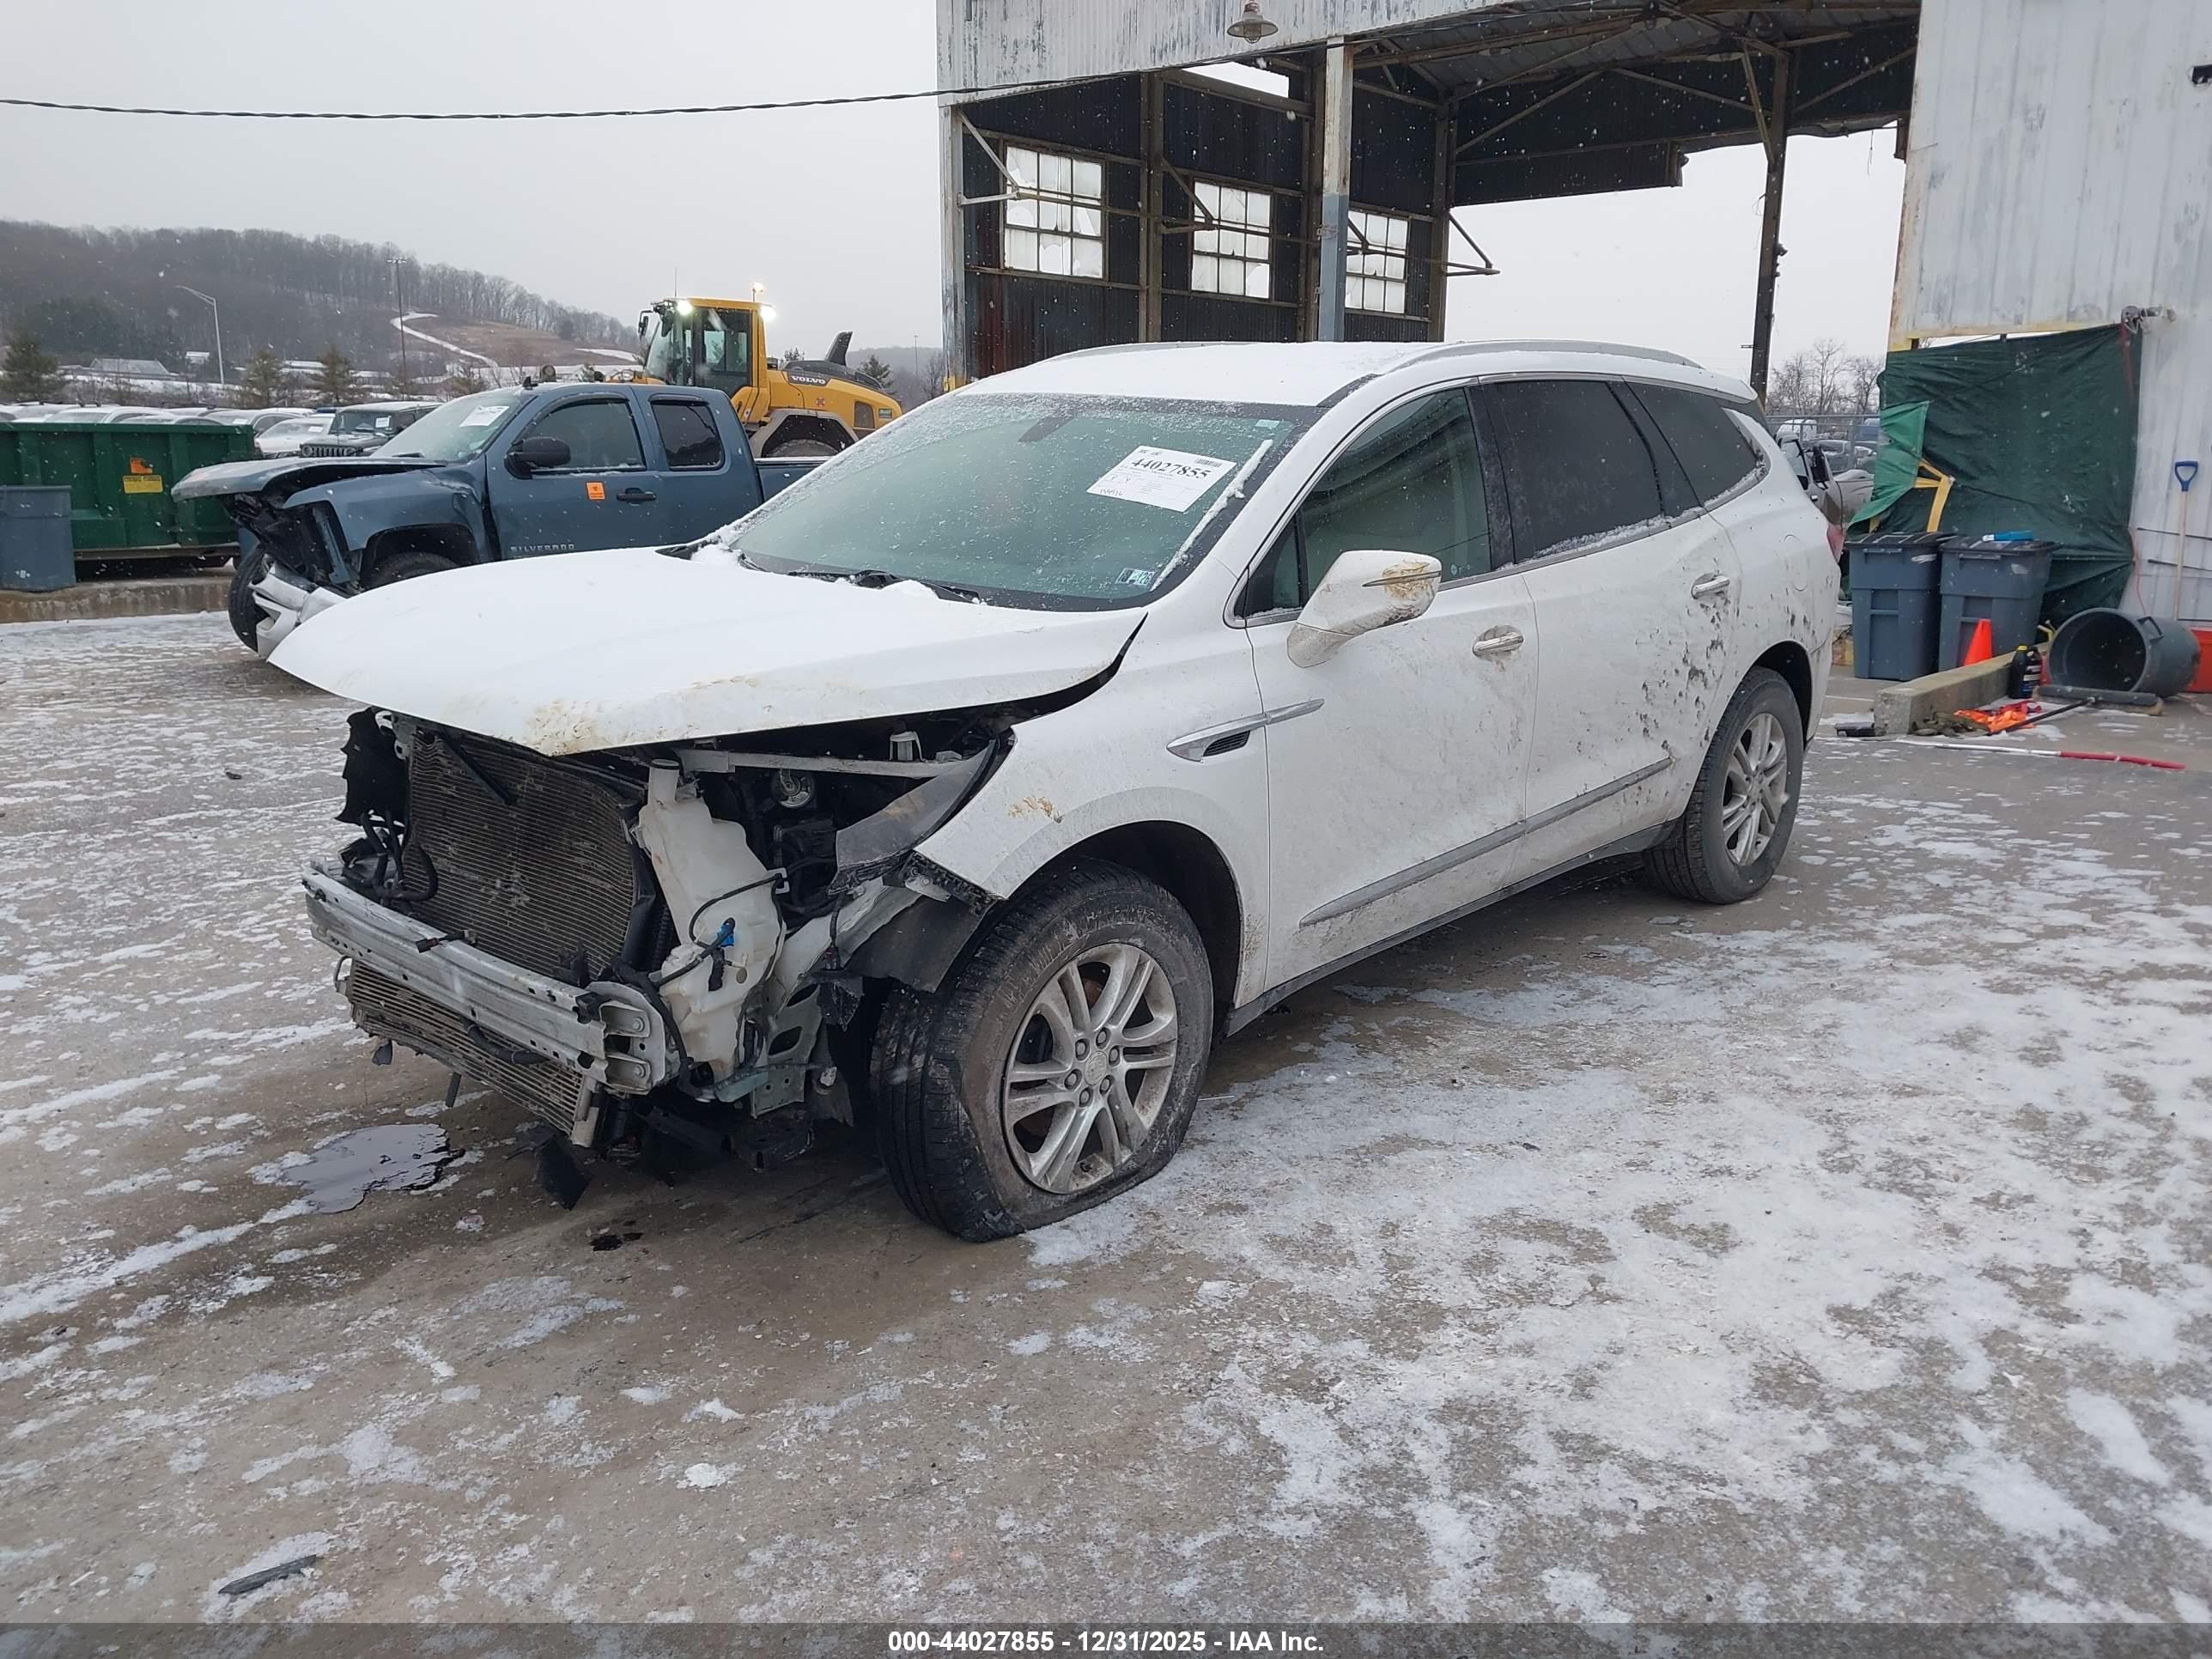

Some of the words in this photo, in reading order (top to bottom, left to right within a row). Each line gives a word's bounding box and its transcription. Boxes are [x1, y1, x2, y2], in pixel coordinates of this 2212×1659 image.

[791, 375, 826, 385] VOLVO
[1132, 458, 1212, 479] 44027855
[510, 544, 575, 552] SILVERADO
